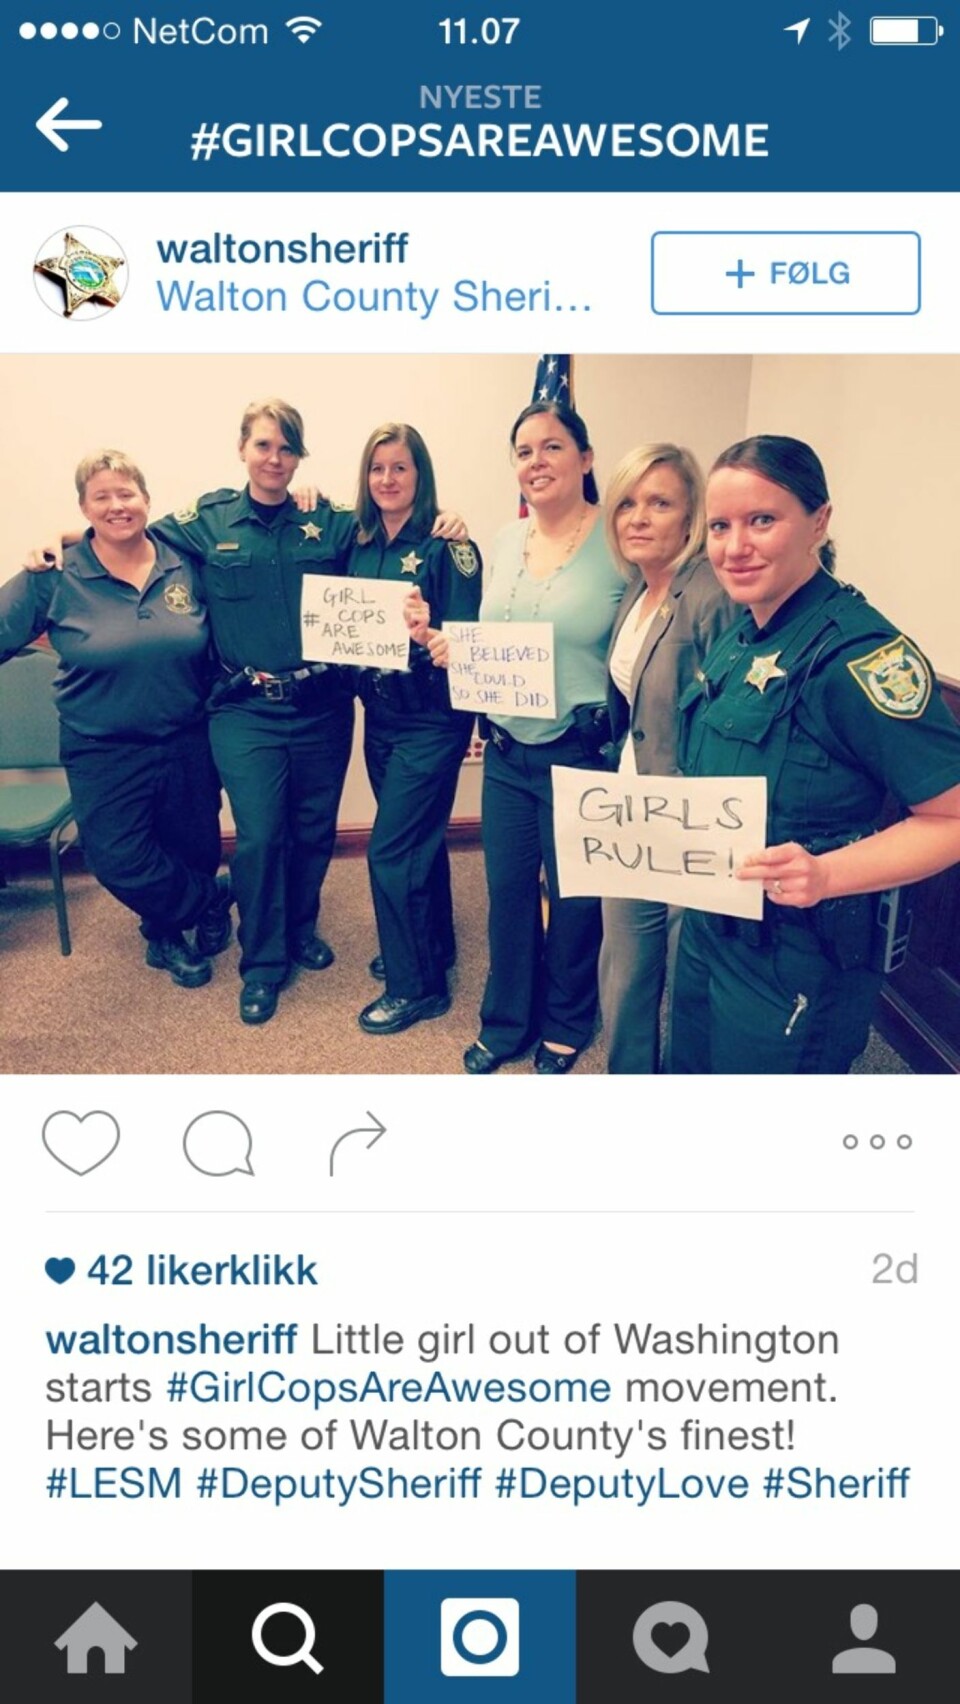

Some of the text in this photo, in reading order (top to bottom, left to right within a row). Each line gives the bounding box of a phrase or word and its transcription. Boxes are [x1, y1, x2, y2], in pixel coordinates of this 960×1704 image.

[133, 15, 521, 46] NetCom 11.07
[420, 84, 542, 110] NYESTE
[190, 122, 769, 162] #GIRLCOPSAREAWESOME
[155, 231, 410, 265] waltonsheriff
[770, 259, 850, 288] FØLG
[155, 279, 287, 313] Walton
[302, 278, 440, 321] County
[323, 587, 376, 608] GIRL
[321, 622, 360, 638] ARE
[338, 609, 386, 625] COPS
[331, 641, 407, 658] AWESOME
[449, 625, 483, 643] SHE
[451, 662, 478, 676] SHE
[470, 645, 550, 663] BELIEVED
[474, 671, 526, 688] COULD
[452, 686, 549, 707] SO SHE DID
[579, 787, 744, 830] GIRLS
[583, 836, 734, 878] RULE!
[87, 1253, 319, 1287] 42 likerklikk
[872, 1252, 918, 1284] 2d
[44, 1322, 839, 1364] waltonsheriff Little girl out of Washington
[45, 1369, 837, 1411] starts #GirlCopsAreAwesome movement.
[47, 1417, 795, 1460] Here's some of Walton County's finest!
[45, 1465, 912, 1508] #LESM #DeputySheriff #DeputyLove #Sheriff
